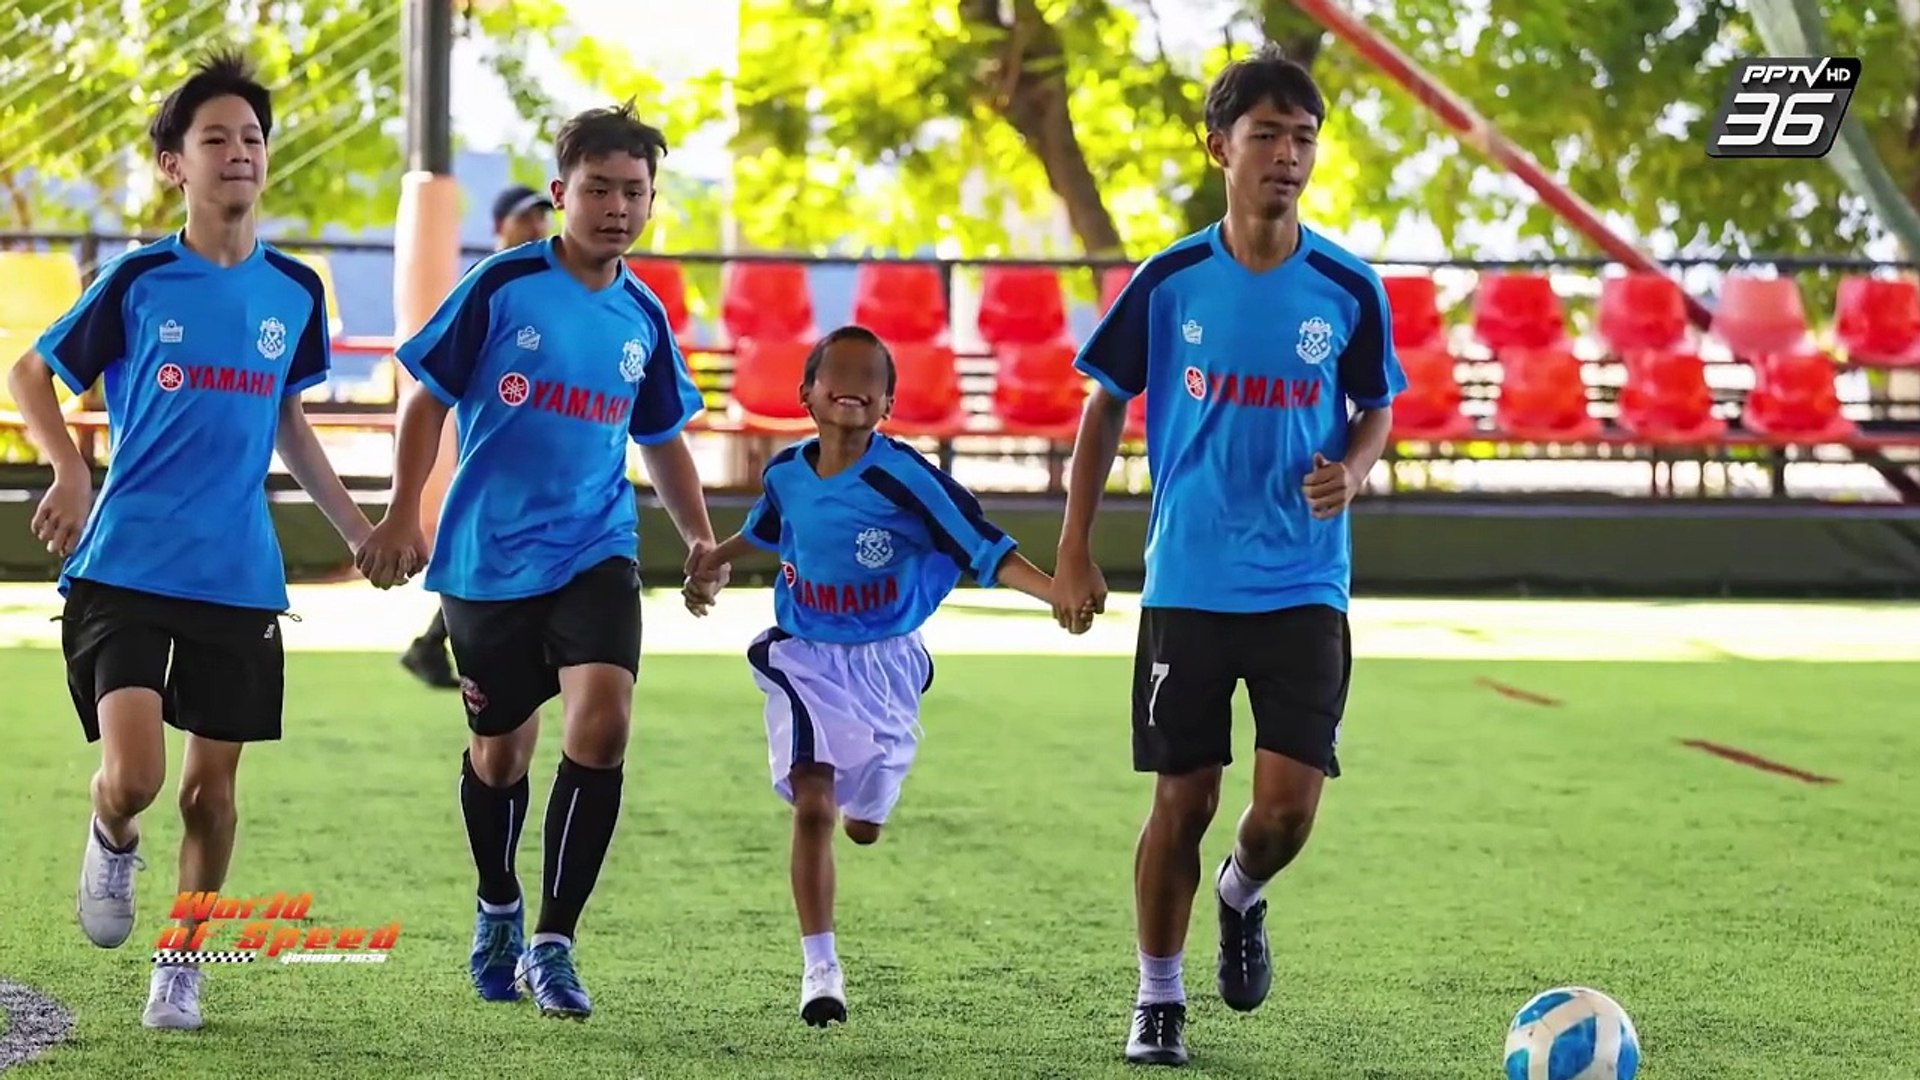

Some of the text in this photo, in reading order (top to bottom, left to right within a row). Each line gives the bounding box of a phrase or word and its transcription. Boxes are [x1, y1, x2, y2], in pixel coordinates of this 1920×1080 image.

[186, 365, 276, 397] YAMAHA
[1208, 371, 1322, 408] YAMAHA
[1148, 662, 1170, 727] 7
